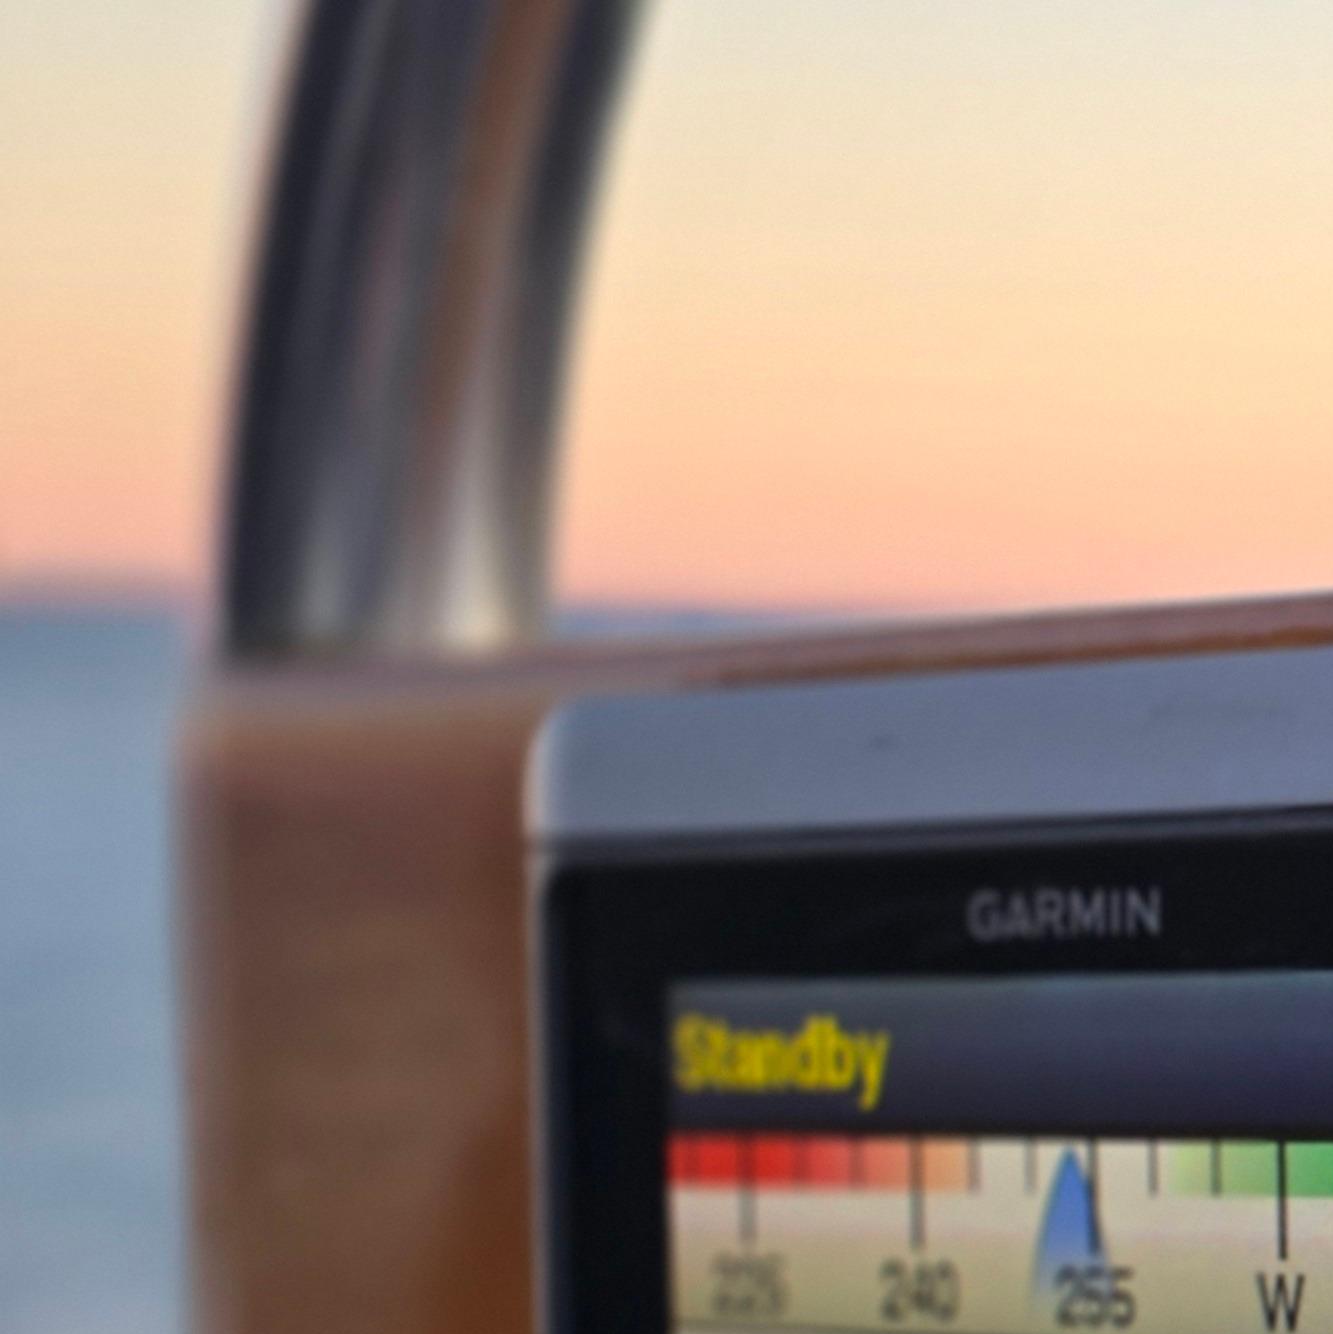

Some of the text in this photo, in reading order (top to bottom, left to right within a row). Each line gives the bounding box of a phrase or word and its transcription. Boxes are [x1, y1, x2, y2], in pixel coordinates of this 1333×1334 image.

[966, 887, 1164, 942] GARMIN
[672, 1012, 890, 1110] Standby
[879, 1258, 961, 1323] 240
[1053, 1264, 1137, 1331] 255
[1257, 1272, 1306, 1334] W
